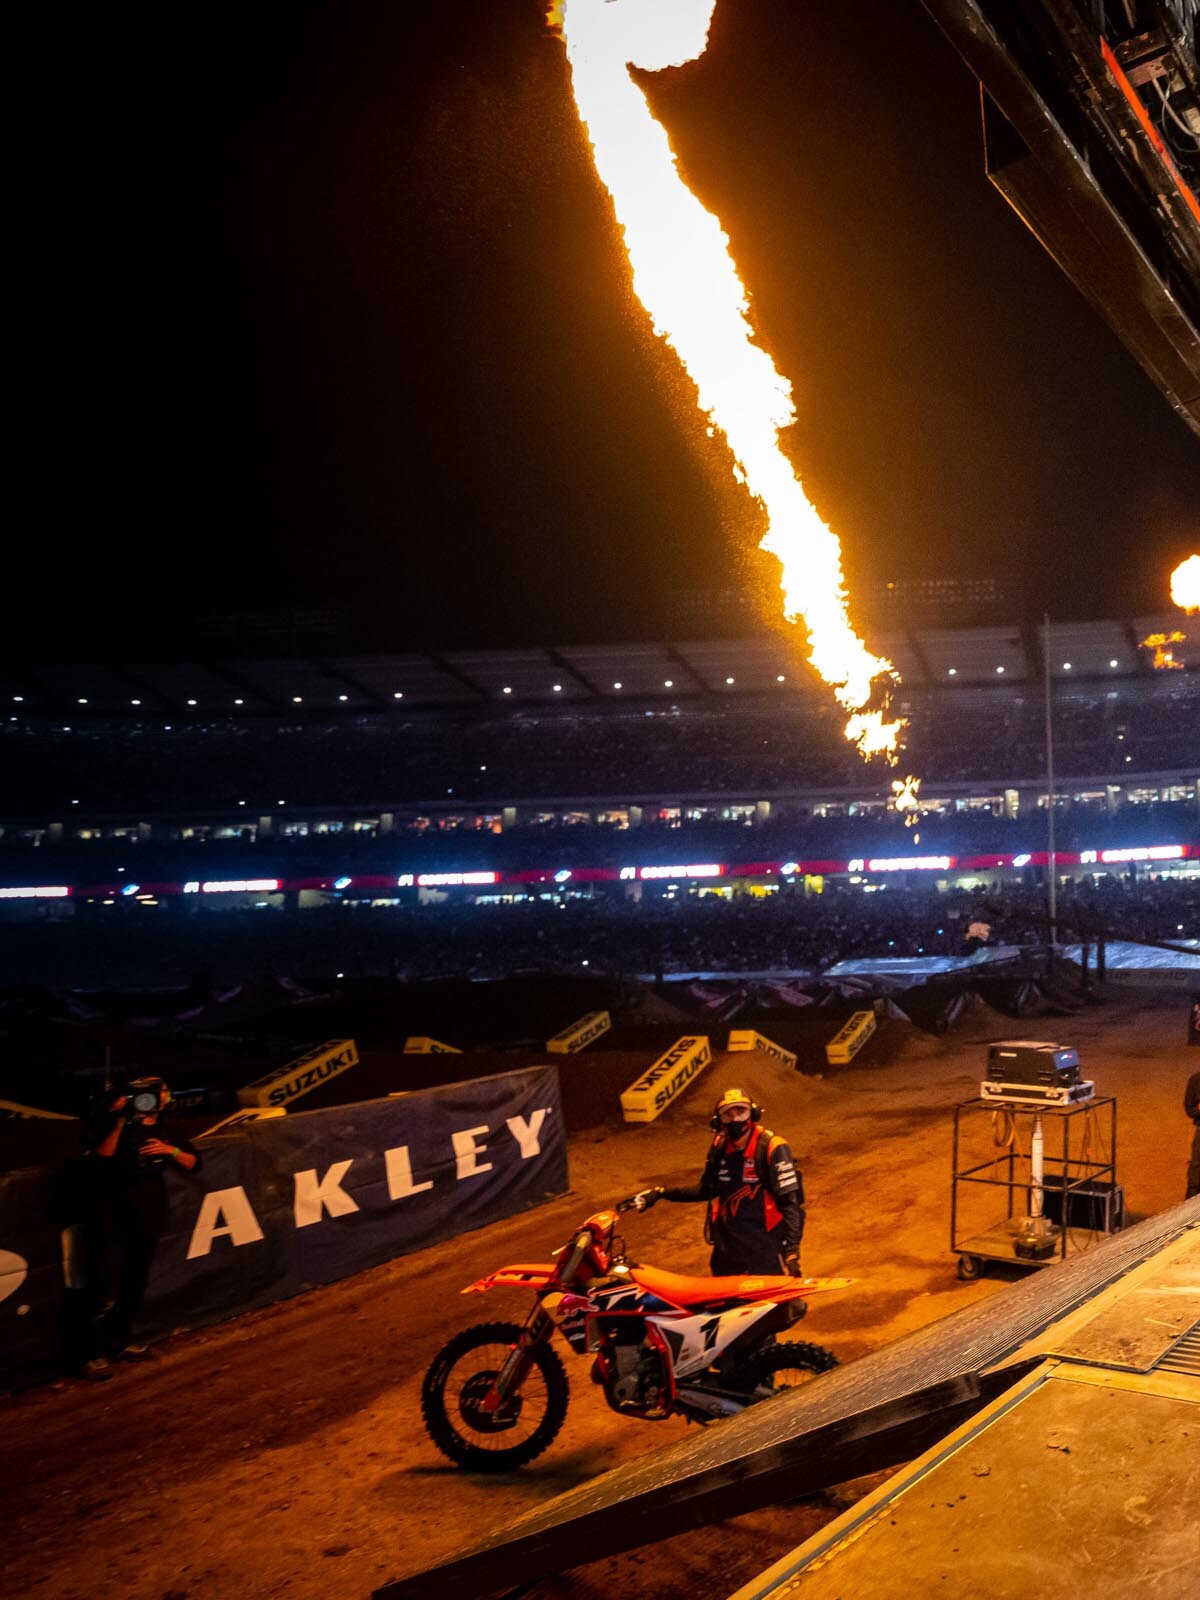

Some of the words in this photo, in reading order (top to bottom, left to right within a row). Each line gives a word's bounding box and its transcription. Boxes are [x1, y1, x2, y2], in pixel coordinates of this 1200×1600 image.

[268, 1048, 354, 1107] SUZUKI
[654, 1046, 709, 1111] SUZUKI
[184, 1108, 548, 1260] AKLEY
